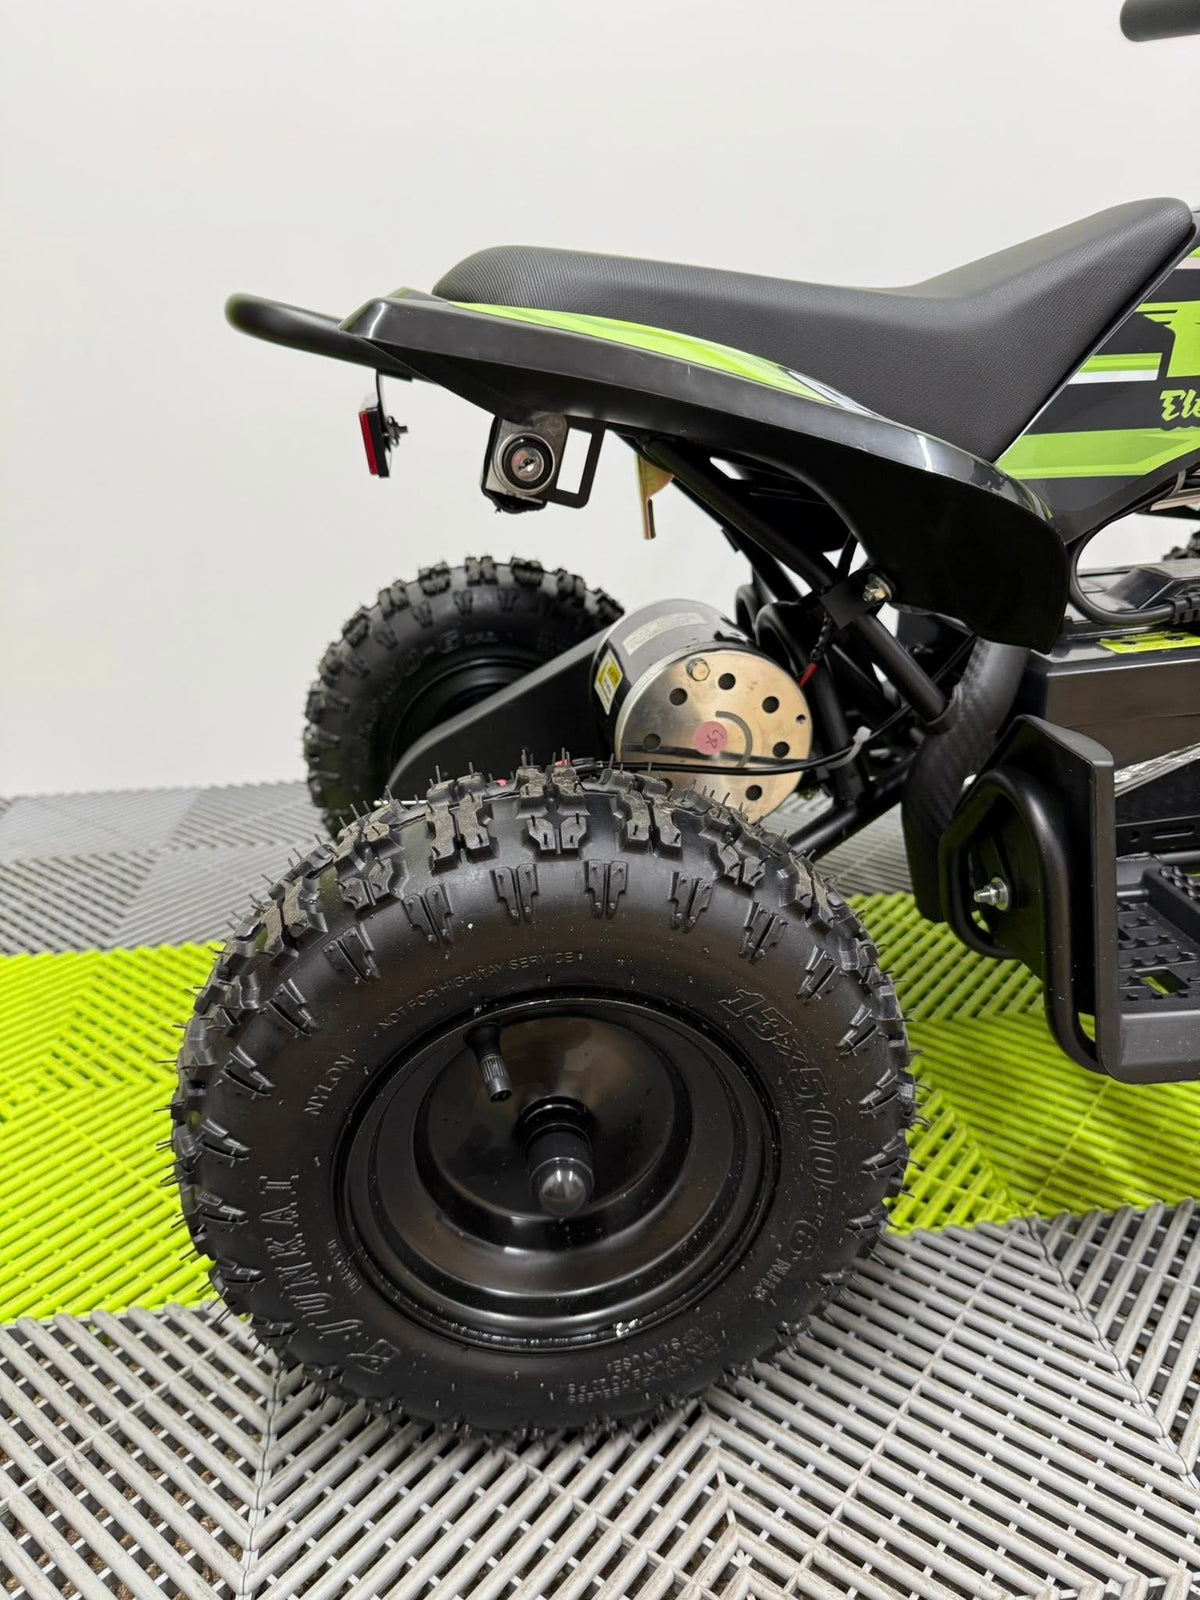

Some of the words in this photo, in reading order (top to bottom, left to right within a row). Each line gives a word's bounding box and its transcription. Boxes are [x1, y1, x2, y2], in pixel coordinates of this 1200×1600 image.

[378, 1005, 411, 1030] NOT
[409, 988, 439, 1008] FOR
[509, 951, 574, 970] SERVICE
[303, 1053, 356, 1115] NYLON
